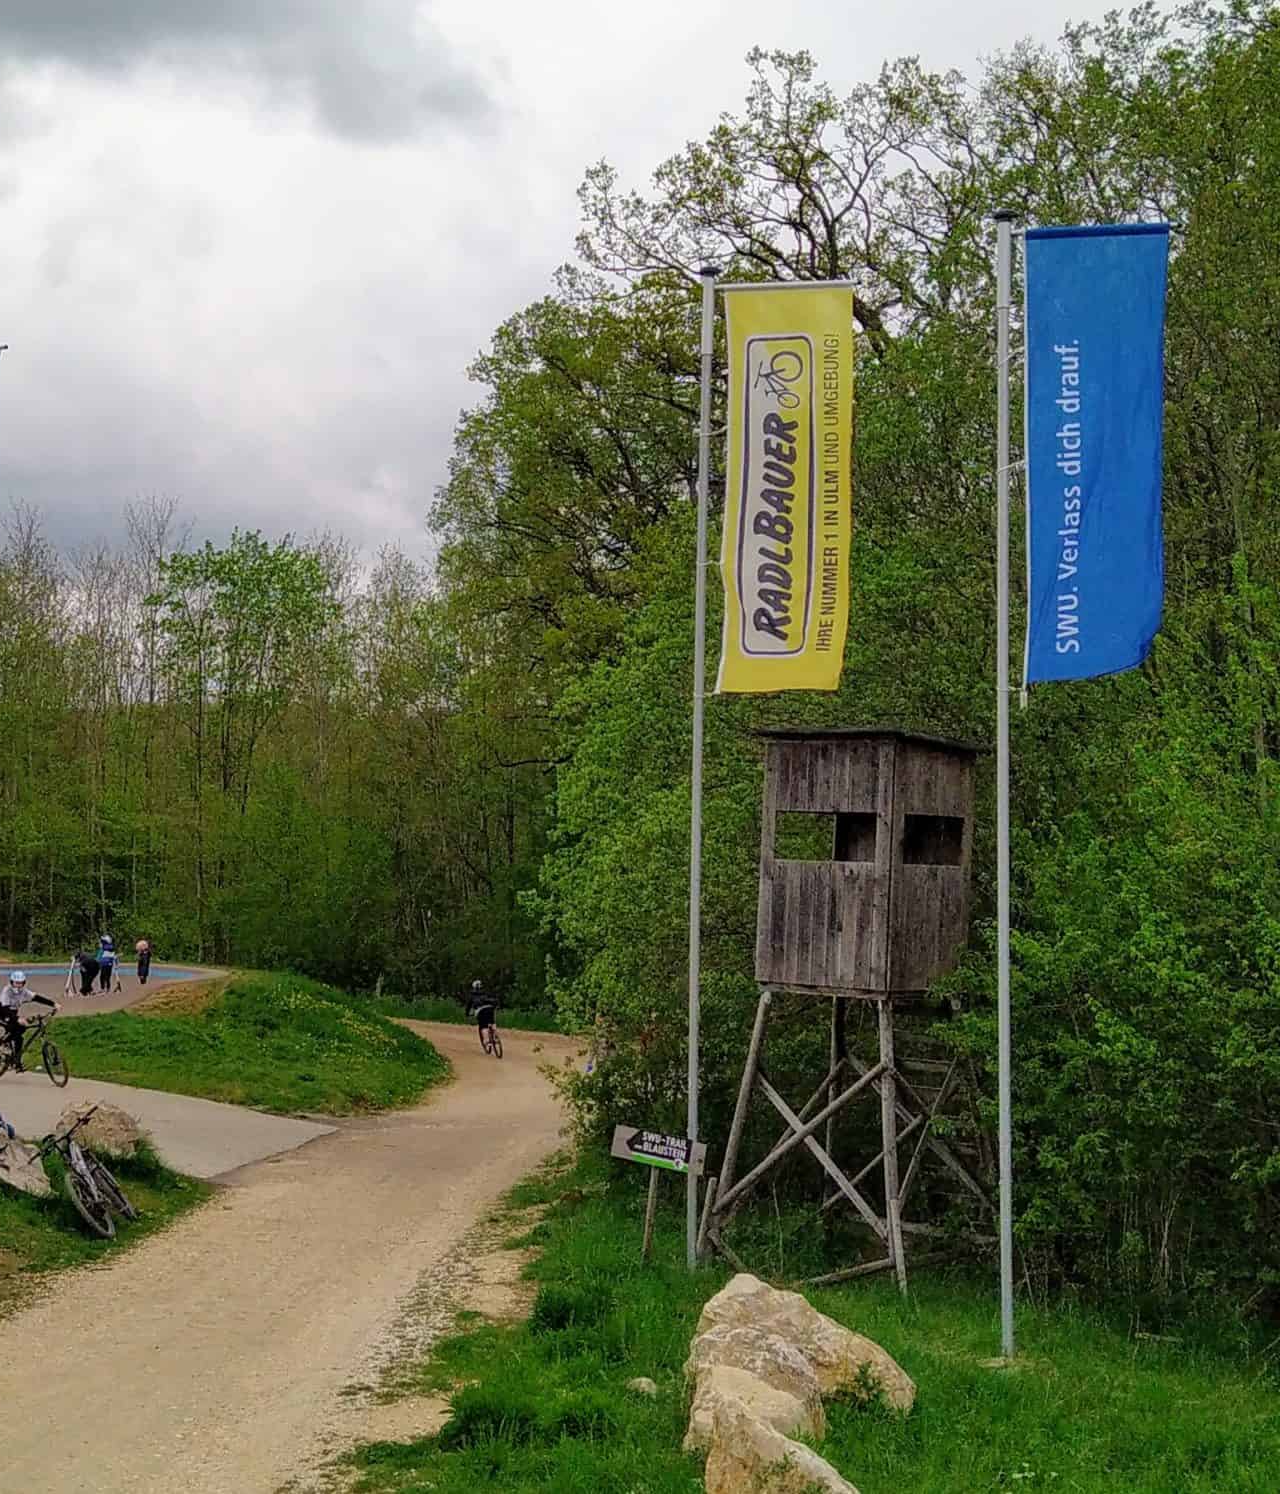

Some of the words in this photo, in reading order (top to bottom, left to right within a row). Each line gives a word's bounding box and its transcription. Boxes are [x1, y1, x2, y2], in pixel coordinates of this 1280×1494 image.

[823, 332, 840, 427] UMGEBUNG!
[1053, 339, 1081, 414] drauf.
[824, 431, 840, 465] UND
[1055, 422, 1081, 476] dich
[824, 470, 840, 505] ULM
[752, 412, 800, 642] RADLBAUER
[824, 510, 840, 526] IN
[824, 533, 839, 541] 1
[1057, 485, 1081, 581] Verlass
[821, 546, 839, 616] NUMMER
[815, 618, 835, 652] IHRE
[643, 1141, 687, 1160] BLAUSTEIN
